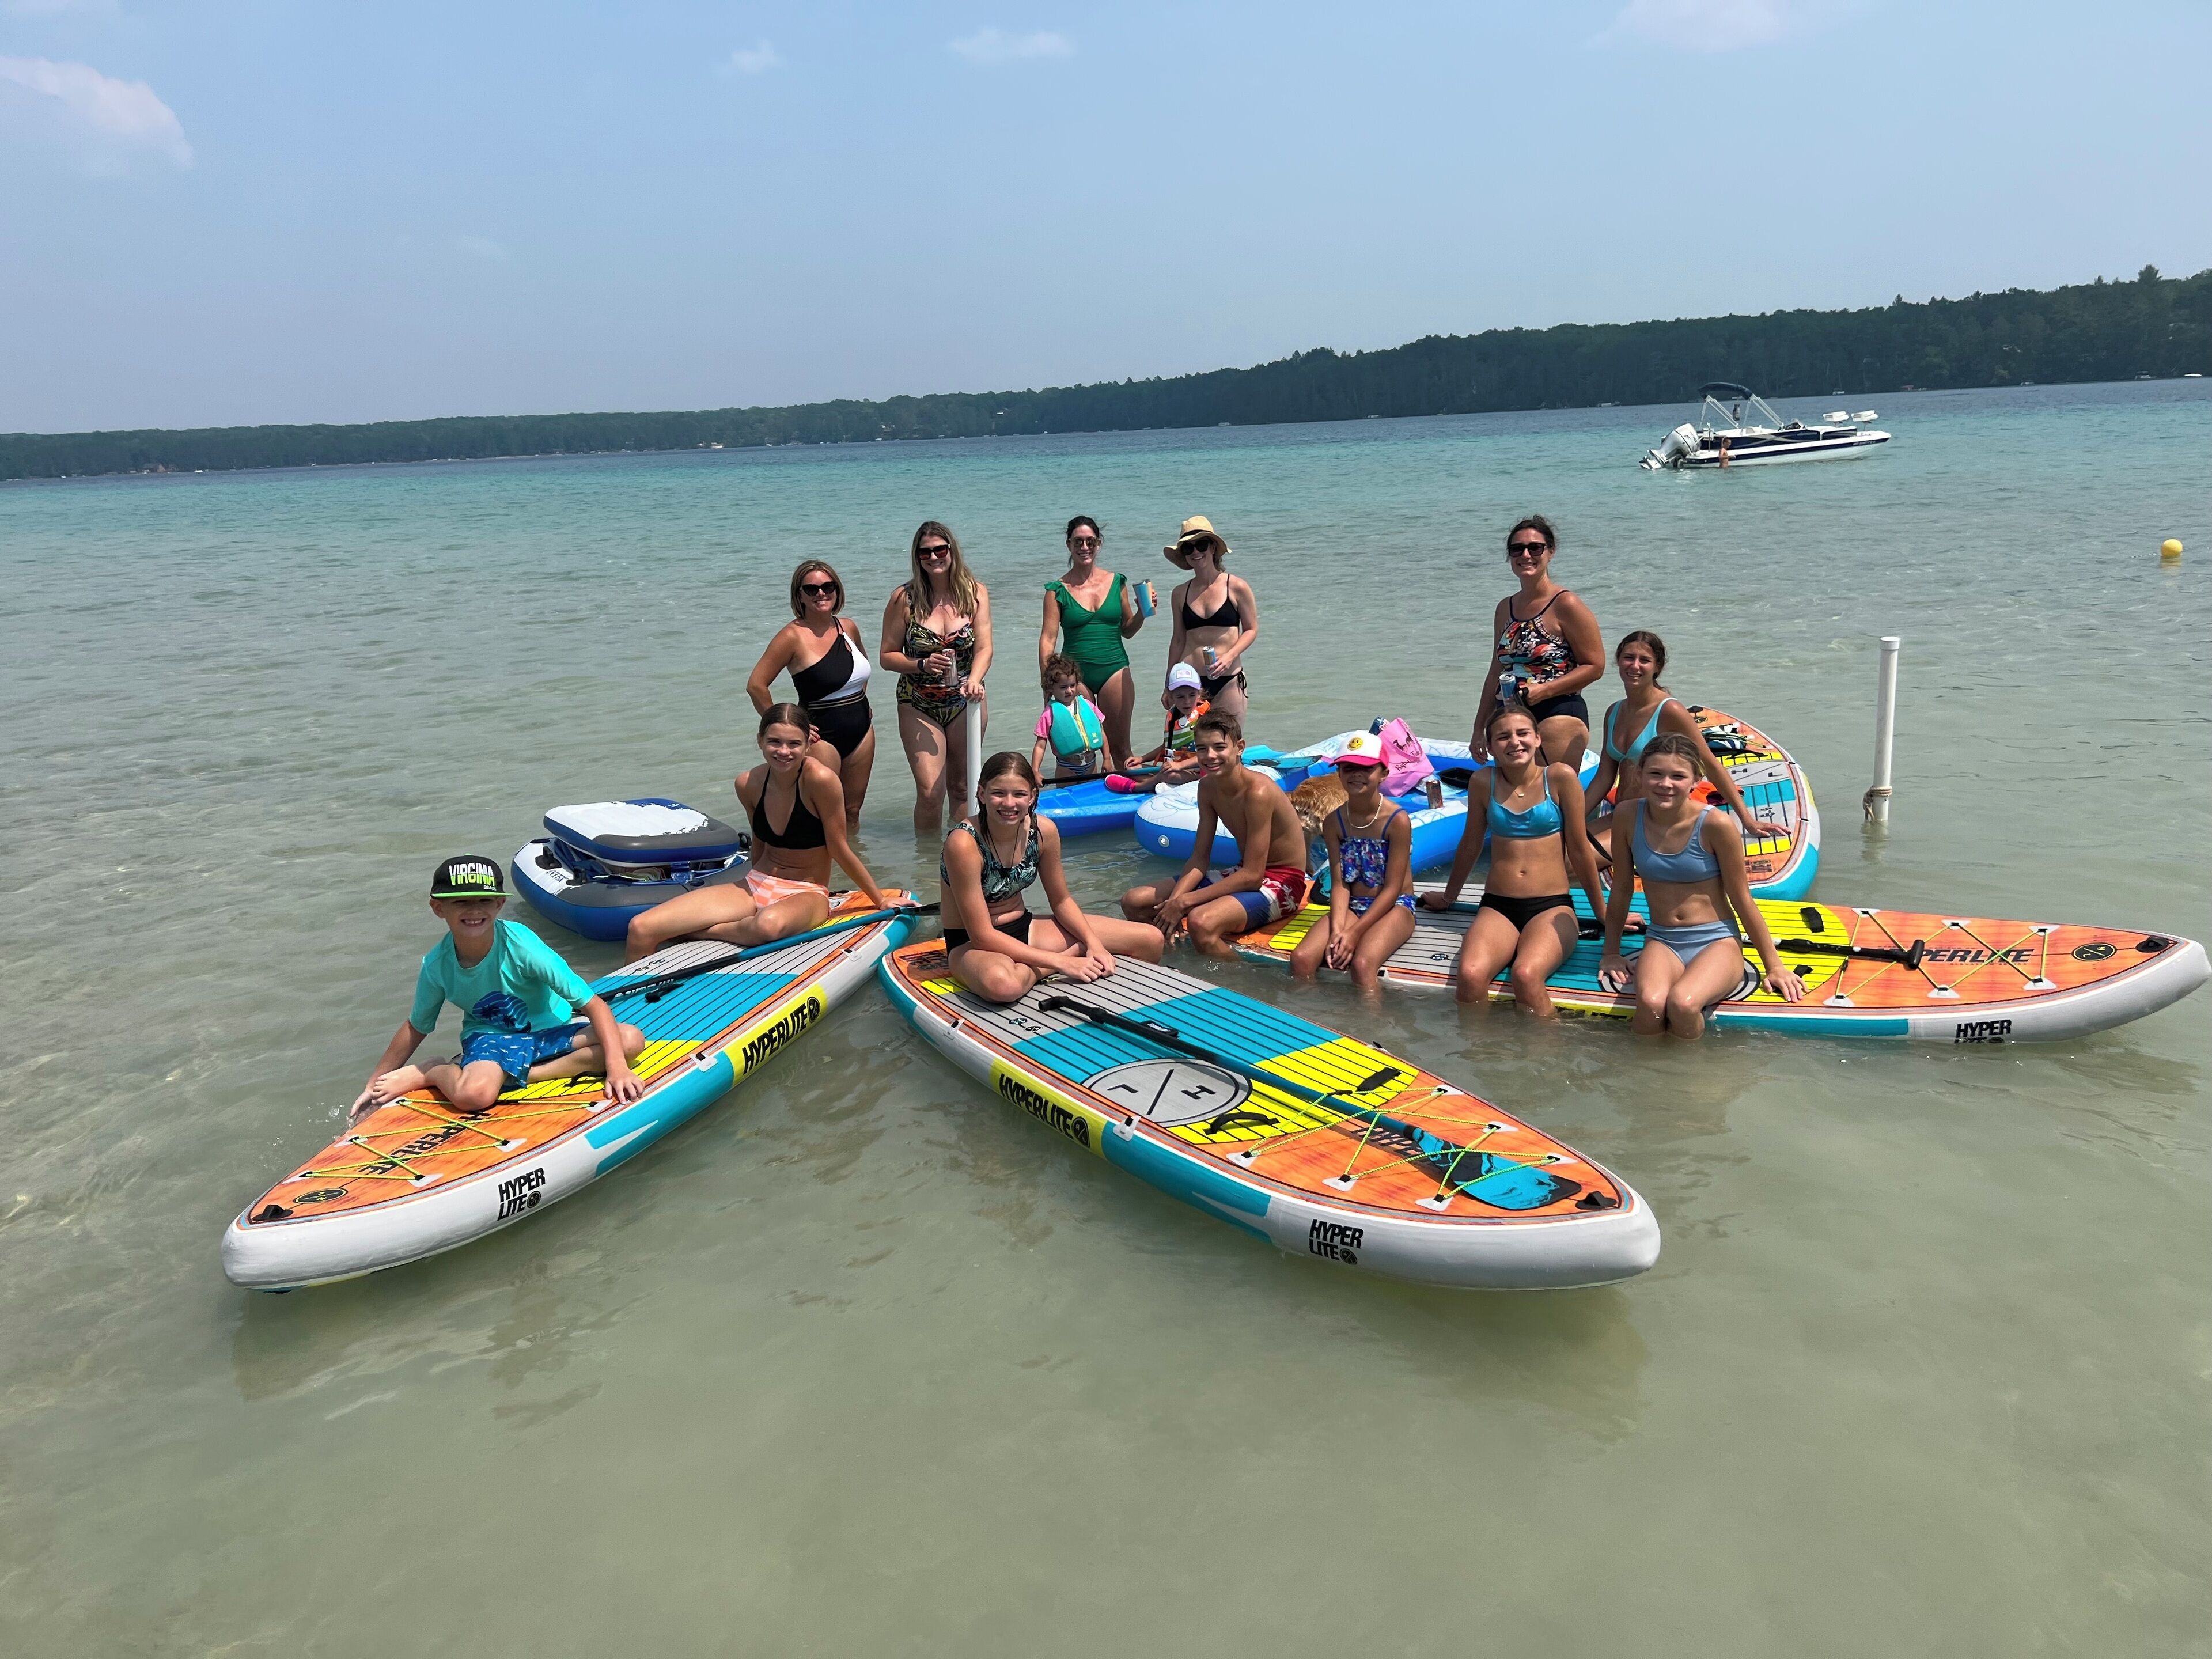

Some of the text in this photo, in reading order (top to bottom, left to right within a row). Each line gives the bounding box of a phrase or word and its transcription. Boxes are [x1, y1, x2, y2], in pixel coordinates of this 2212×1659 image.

[448, 862, 495, 886] VIRGINIA
[741, 1003, 808, 1075] HYPERLITE
[1956, 1019, 2012, 1039] HYPER
[999, 1073, 1074, 1139] HYPERLITE
[498, 1168, 546, 1203] HYPER
[497, 1193, 528, 1221] LITE
[1309, 1218, 1364, 1249] HYPER
[1309, 1238, 1340, 1261] LITE
